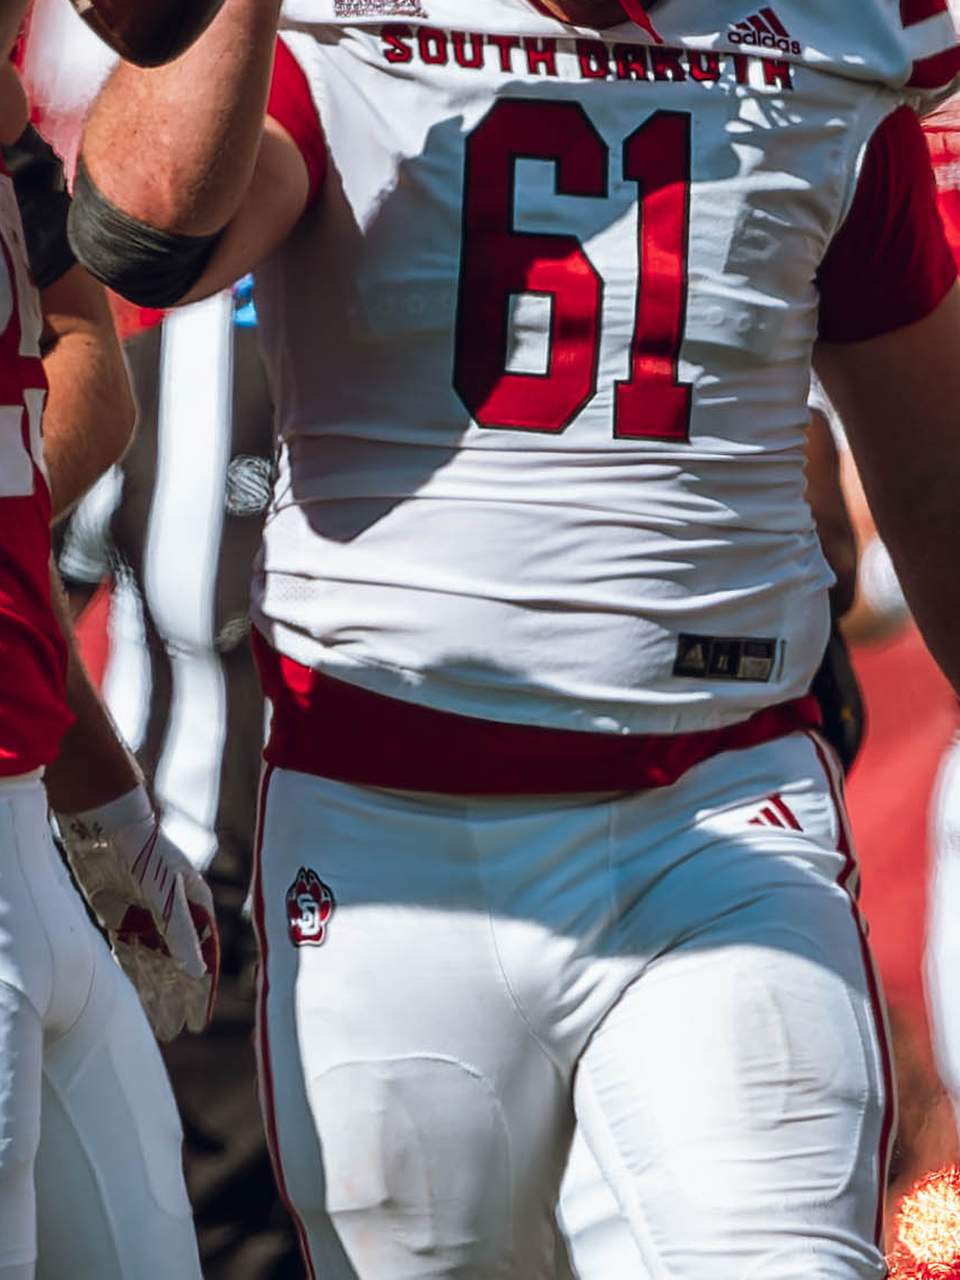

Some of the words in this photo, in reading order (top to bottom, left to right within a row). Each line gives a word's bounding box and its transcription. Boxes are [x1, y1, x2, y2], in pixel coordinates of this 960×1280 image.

[380, 22, 559, 77] SOUTH
[727, 28, 801, 56] adidas
[452, 97, 692, 444] 61
